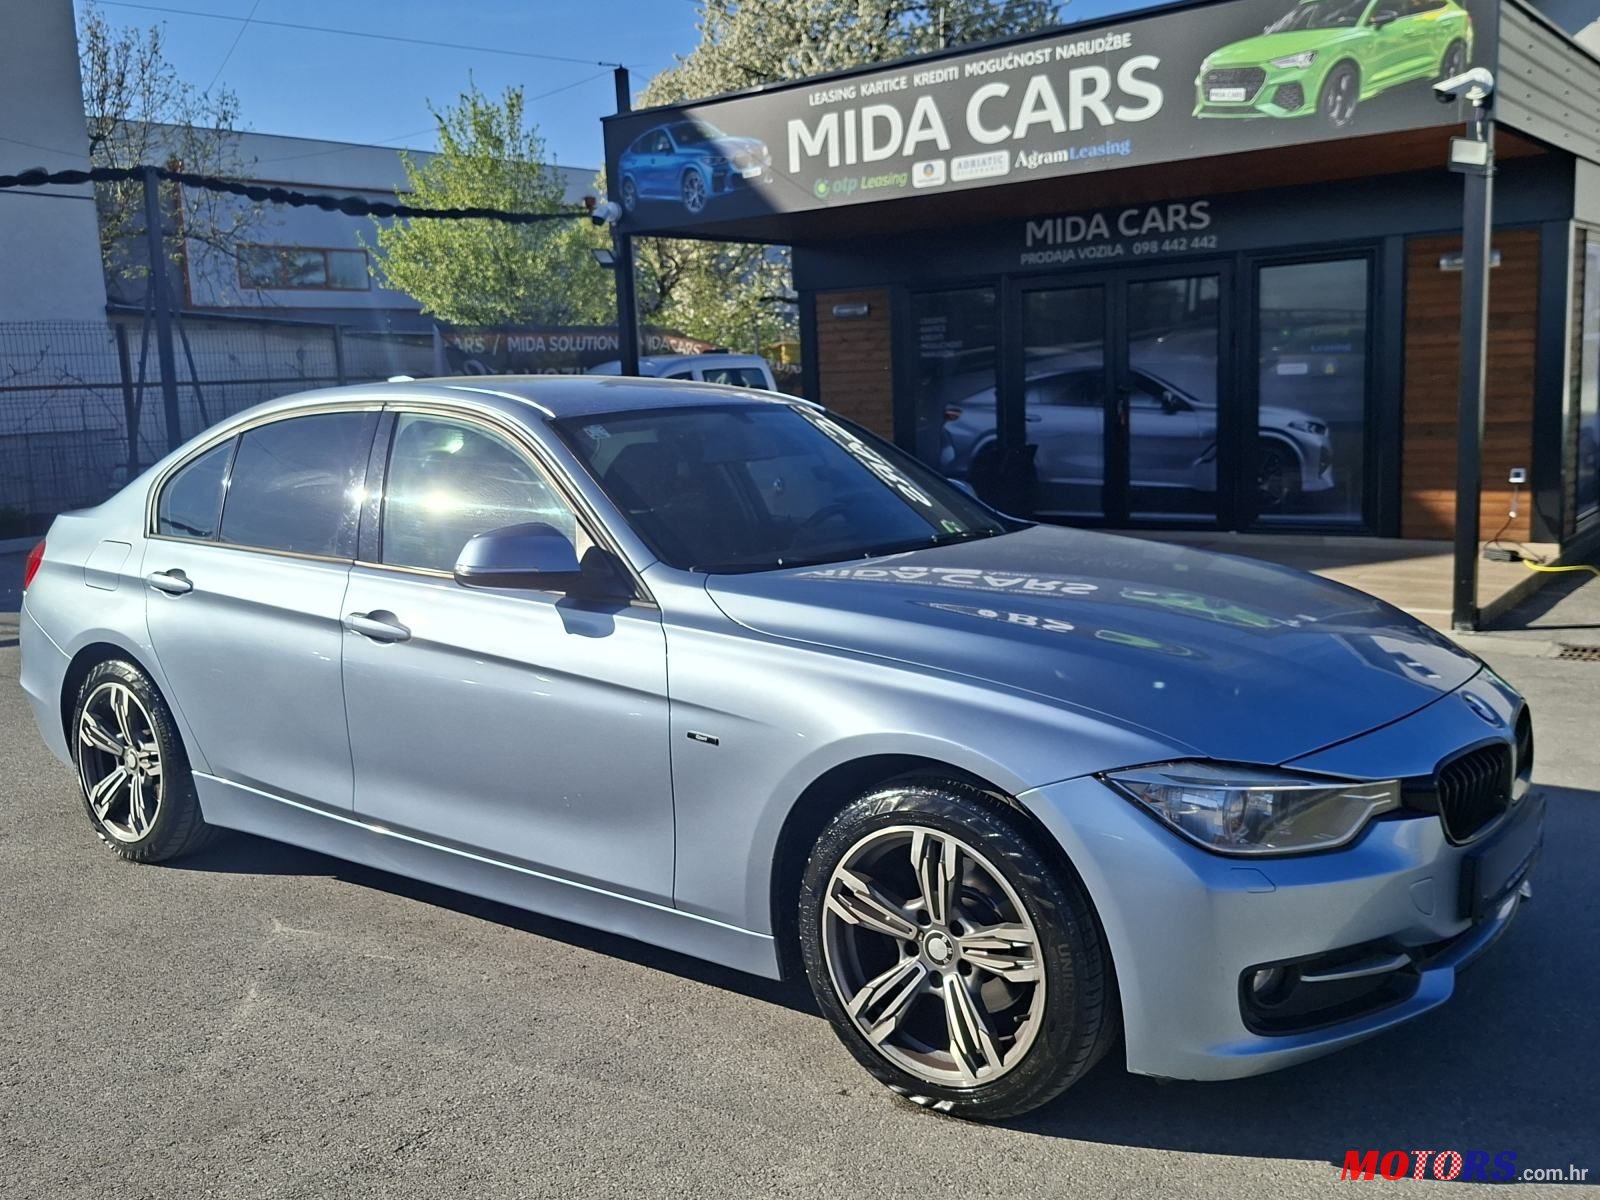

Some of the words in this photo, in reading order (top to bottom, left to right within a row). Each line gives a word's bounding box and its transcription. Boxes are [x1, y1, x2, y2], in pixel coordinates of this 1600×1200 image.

[809, 86, 857, 106] LEASING
[860, 75, 908, 97] KARTICE
[913, 66, 960, 87] KREDITI
[964, 47, 1053, 77] MOGUĆNOST
[1055, 31, 1132, 60] NARUDŽBE
[787, 95, 951, 173] MIDA
[966, 55, 1164, 145] CARS
[860, 172, 908, 189] Leasing
[1025, 213, 1110, 247] MIDA
[1117, 201, 1211, 236] CARS
[1020, 248, 1075, 265] PRODAJA
[1078, 244, 1124, 259] VOZILA
[1161, 238, 1187, 251] 442
[1190, 235, 1217, 249] 442
[507, 335, 546, 353] MIDA
